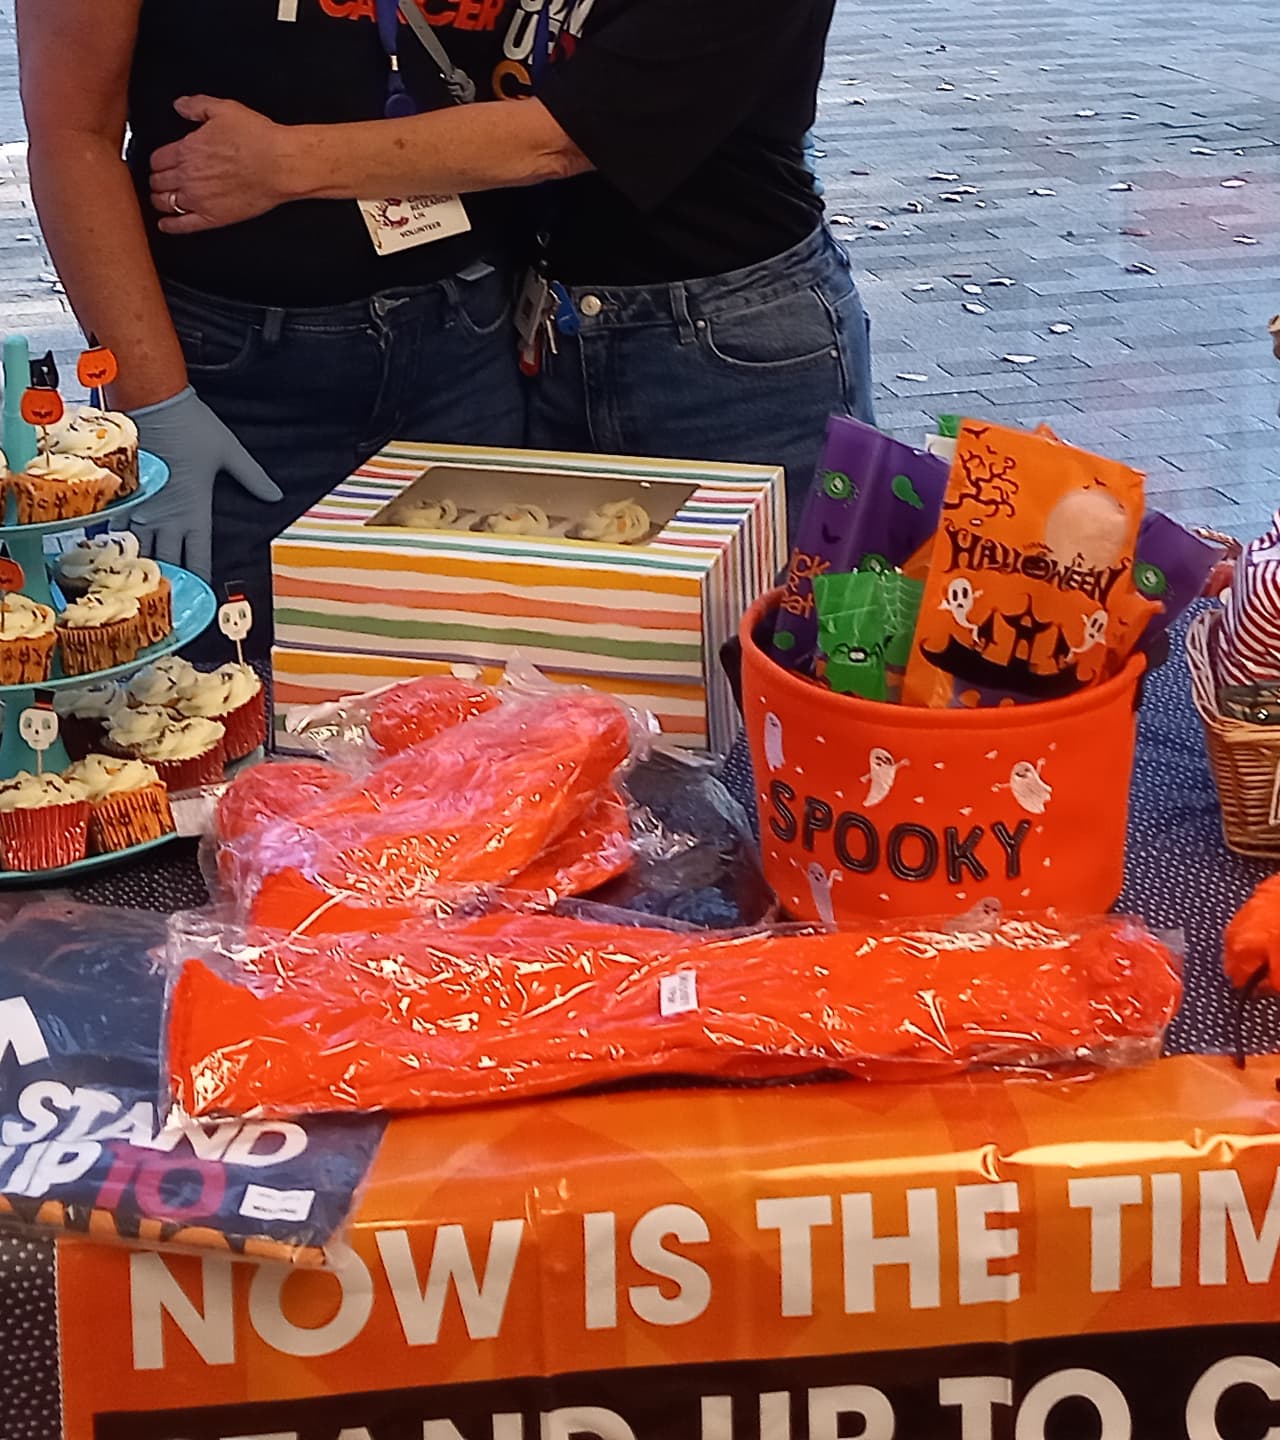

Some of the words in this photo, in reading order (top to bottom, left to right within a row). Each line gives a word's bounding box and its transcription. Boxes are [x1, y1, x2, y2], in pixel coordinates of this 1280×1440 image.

[399, 220, 442, 239] VOLUNTEER
[769, 780, 1032, 885] SPOOKY
[1, 1080, 308, 1166] STAND
[96, 1143, 227, 1222] TO
[130, 1218, 526, 1371] NOW
[584, 1204, 713, 1330] IS
[756, 1181, 1020, 1318] THE
